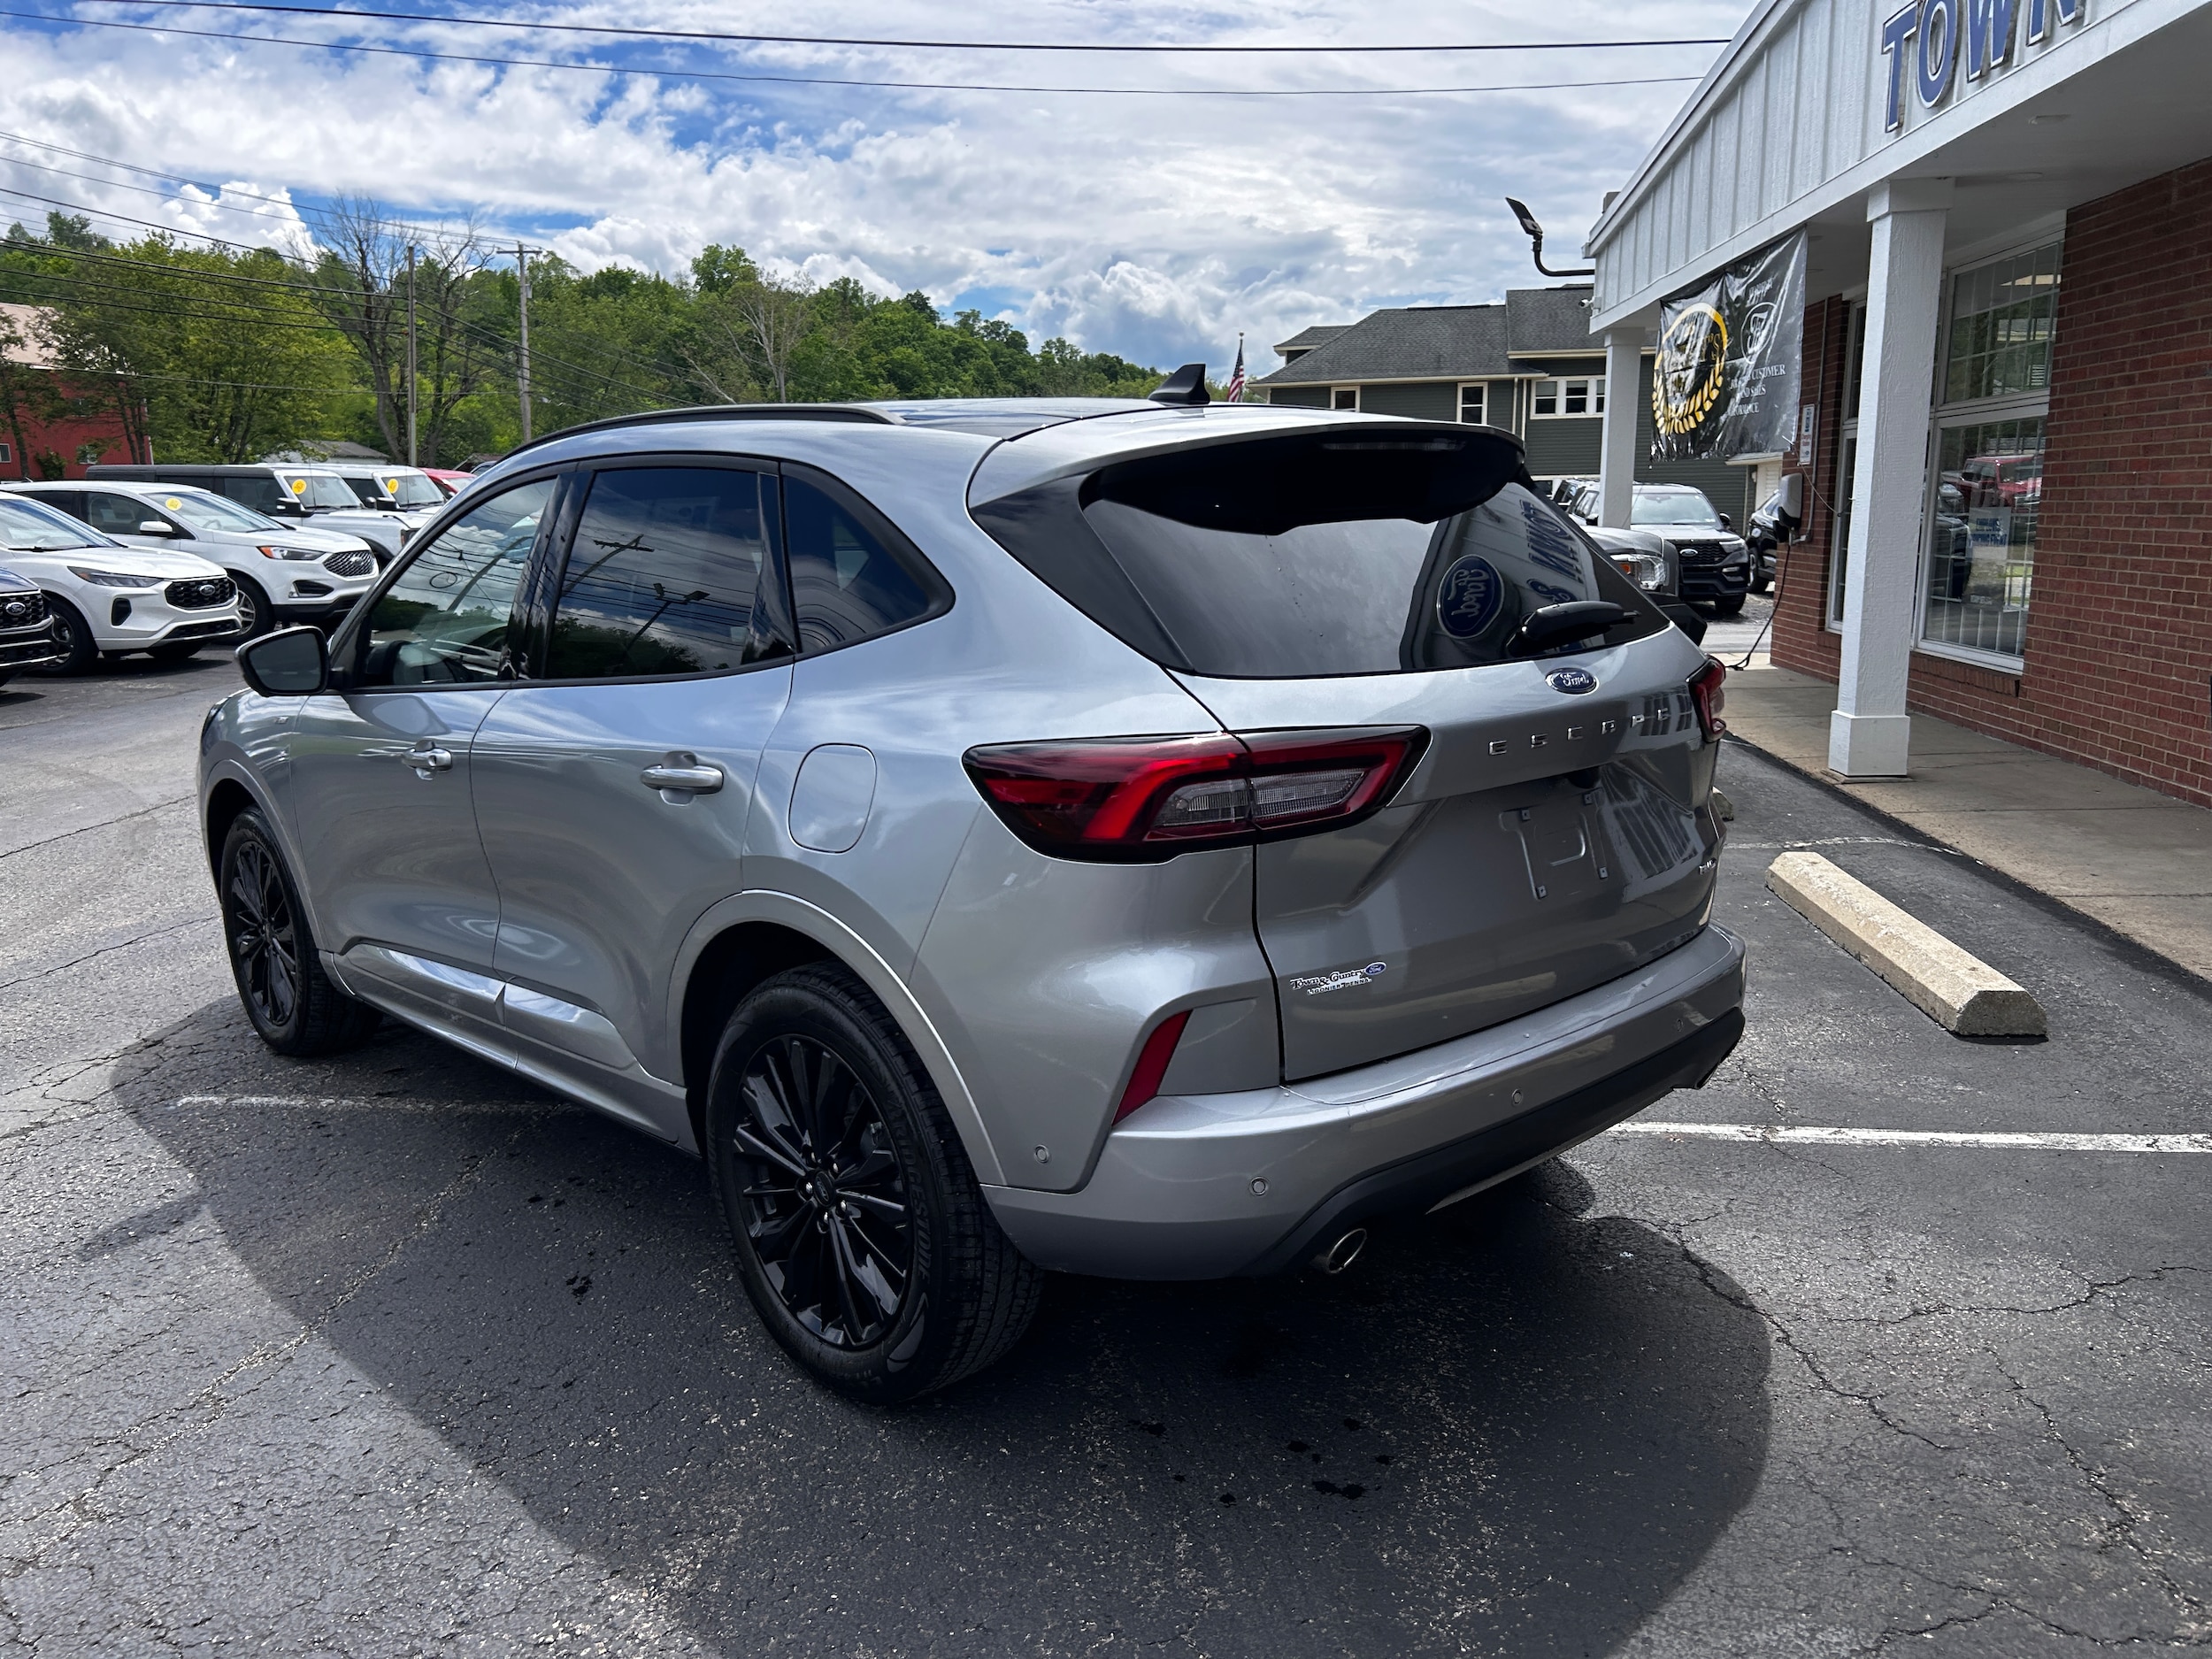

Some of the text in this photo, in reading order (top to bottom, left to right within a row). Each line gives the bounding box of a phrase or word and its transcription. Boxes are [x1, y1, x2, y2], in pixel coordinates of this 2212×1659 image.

[1560, 672, 1590, 687] Ford
[1489, 707, 1671, 756] ESCAPE
[1290, 977, 1318, 990] Town
[1318, 977, 1331, 987] &
